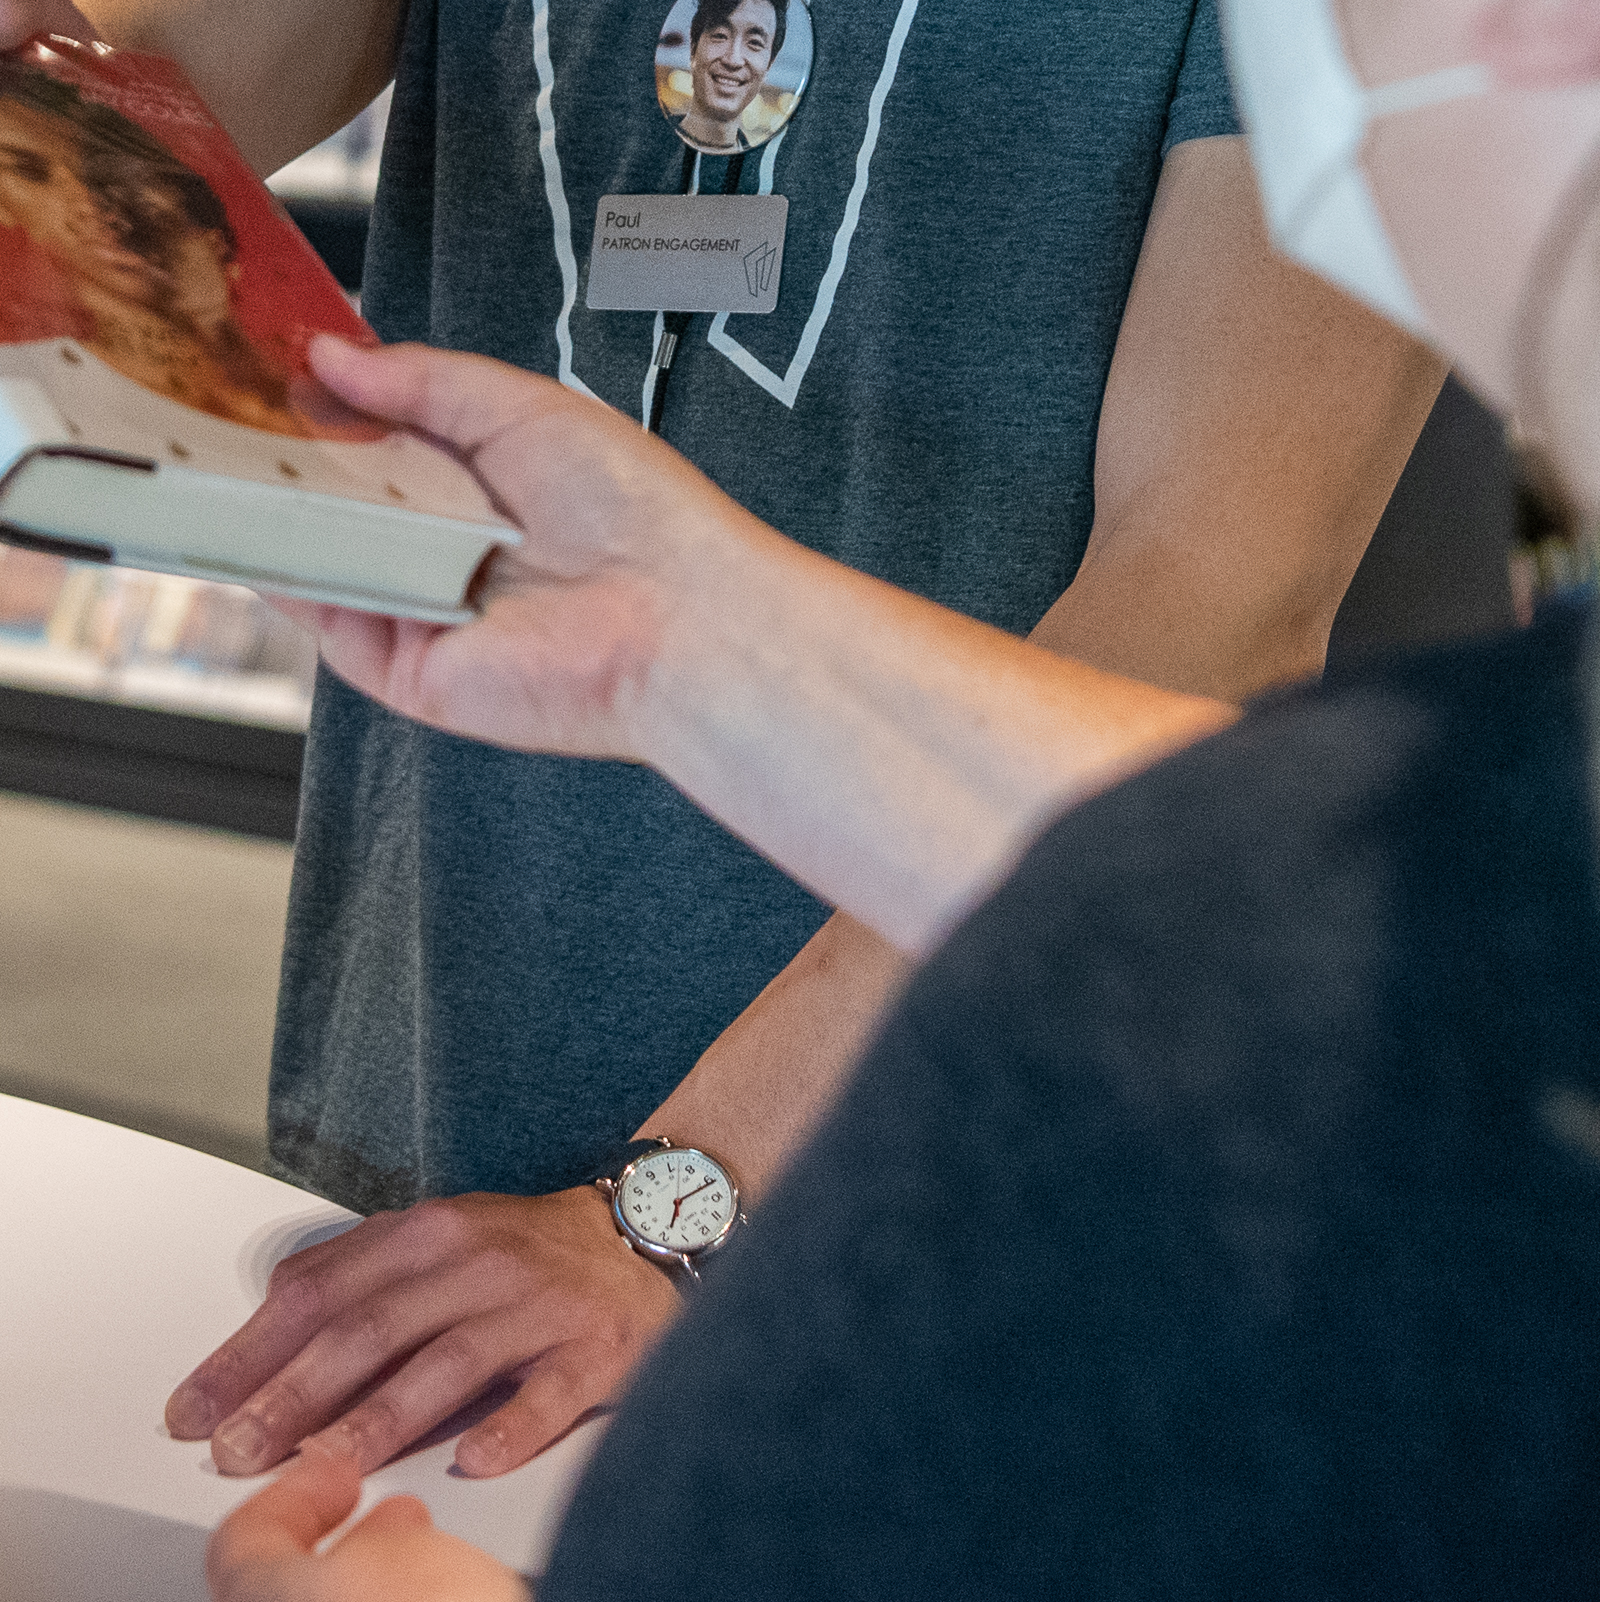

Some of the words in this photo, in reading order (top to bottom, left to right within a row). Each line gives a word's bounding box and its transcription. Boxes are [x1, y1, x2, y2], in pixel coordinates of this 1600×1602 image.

[605, 211, 641, 228] Paul
[602, 237, 651, 250] PATRON
[653, 237, 741, 252] ENGAGEMENT
[684, 1164, 696, 1175] 8
[645, 1170, 656, 1181] 6
[633, 1186, 643, 1197] 5
[711, 1191, 723, 1203] 10
[632, 1203, 643, 1214] 4
[711, 1210, 722, 1221] 11
[640, 1221, 651, 1232] 3
[698, 1225, 711, 1236] 12
[658, 1231, 670, 1242] 2
